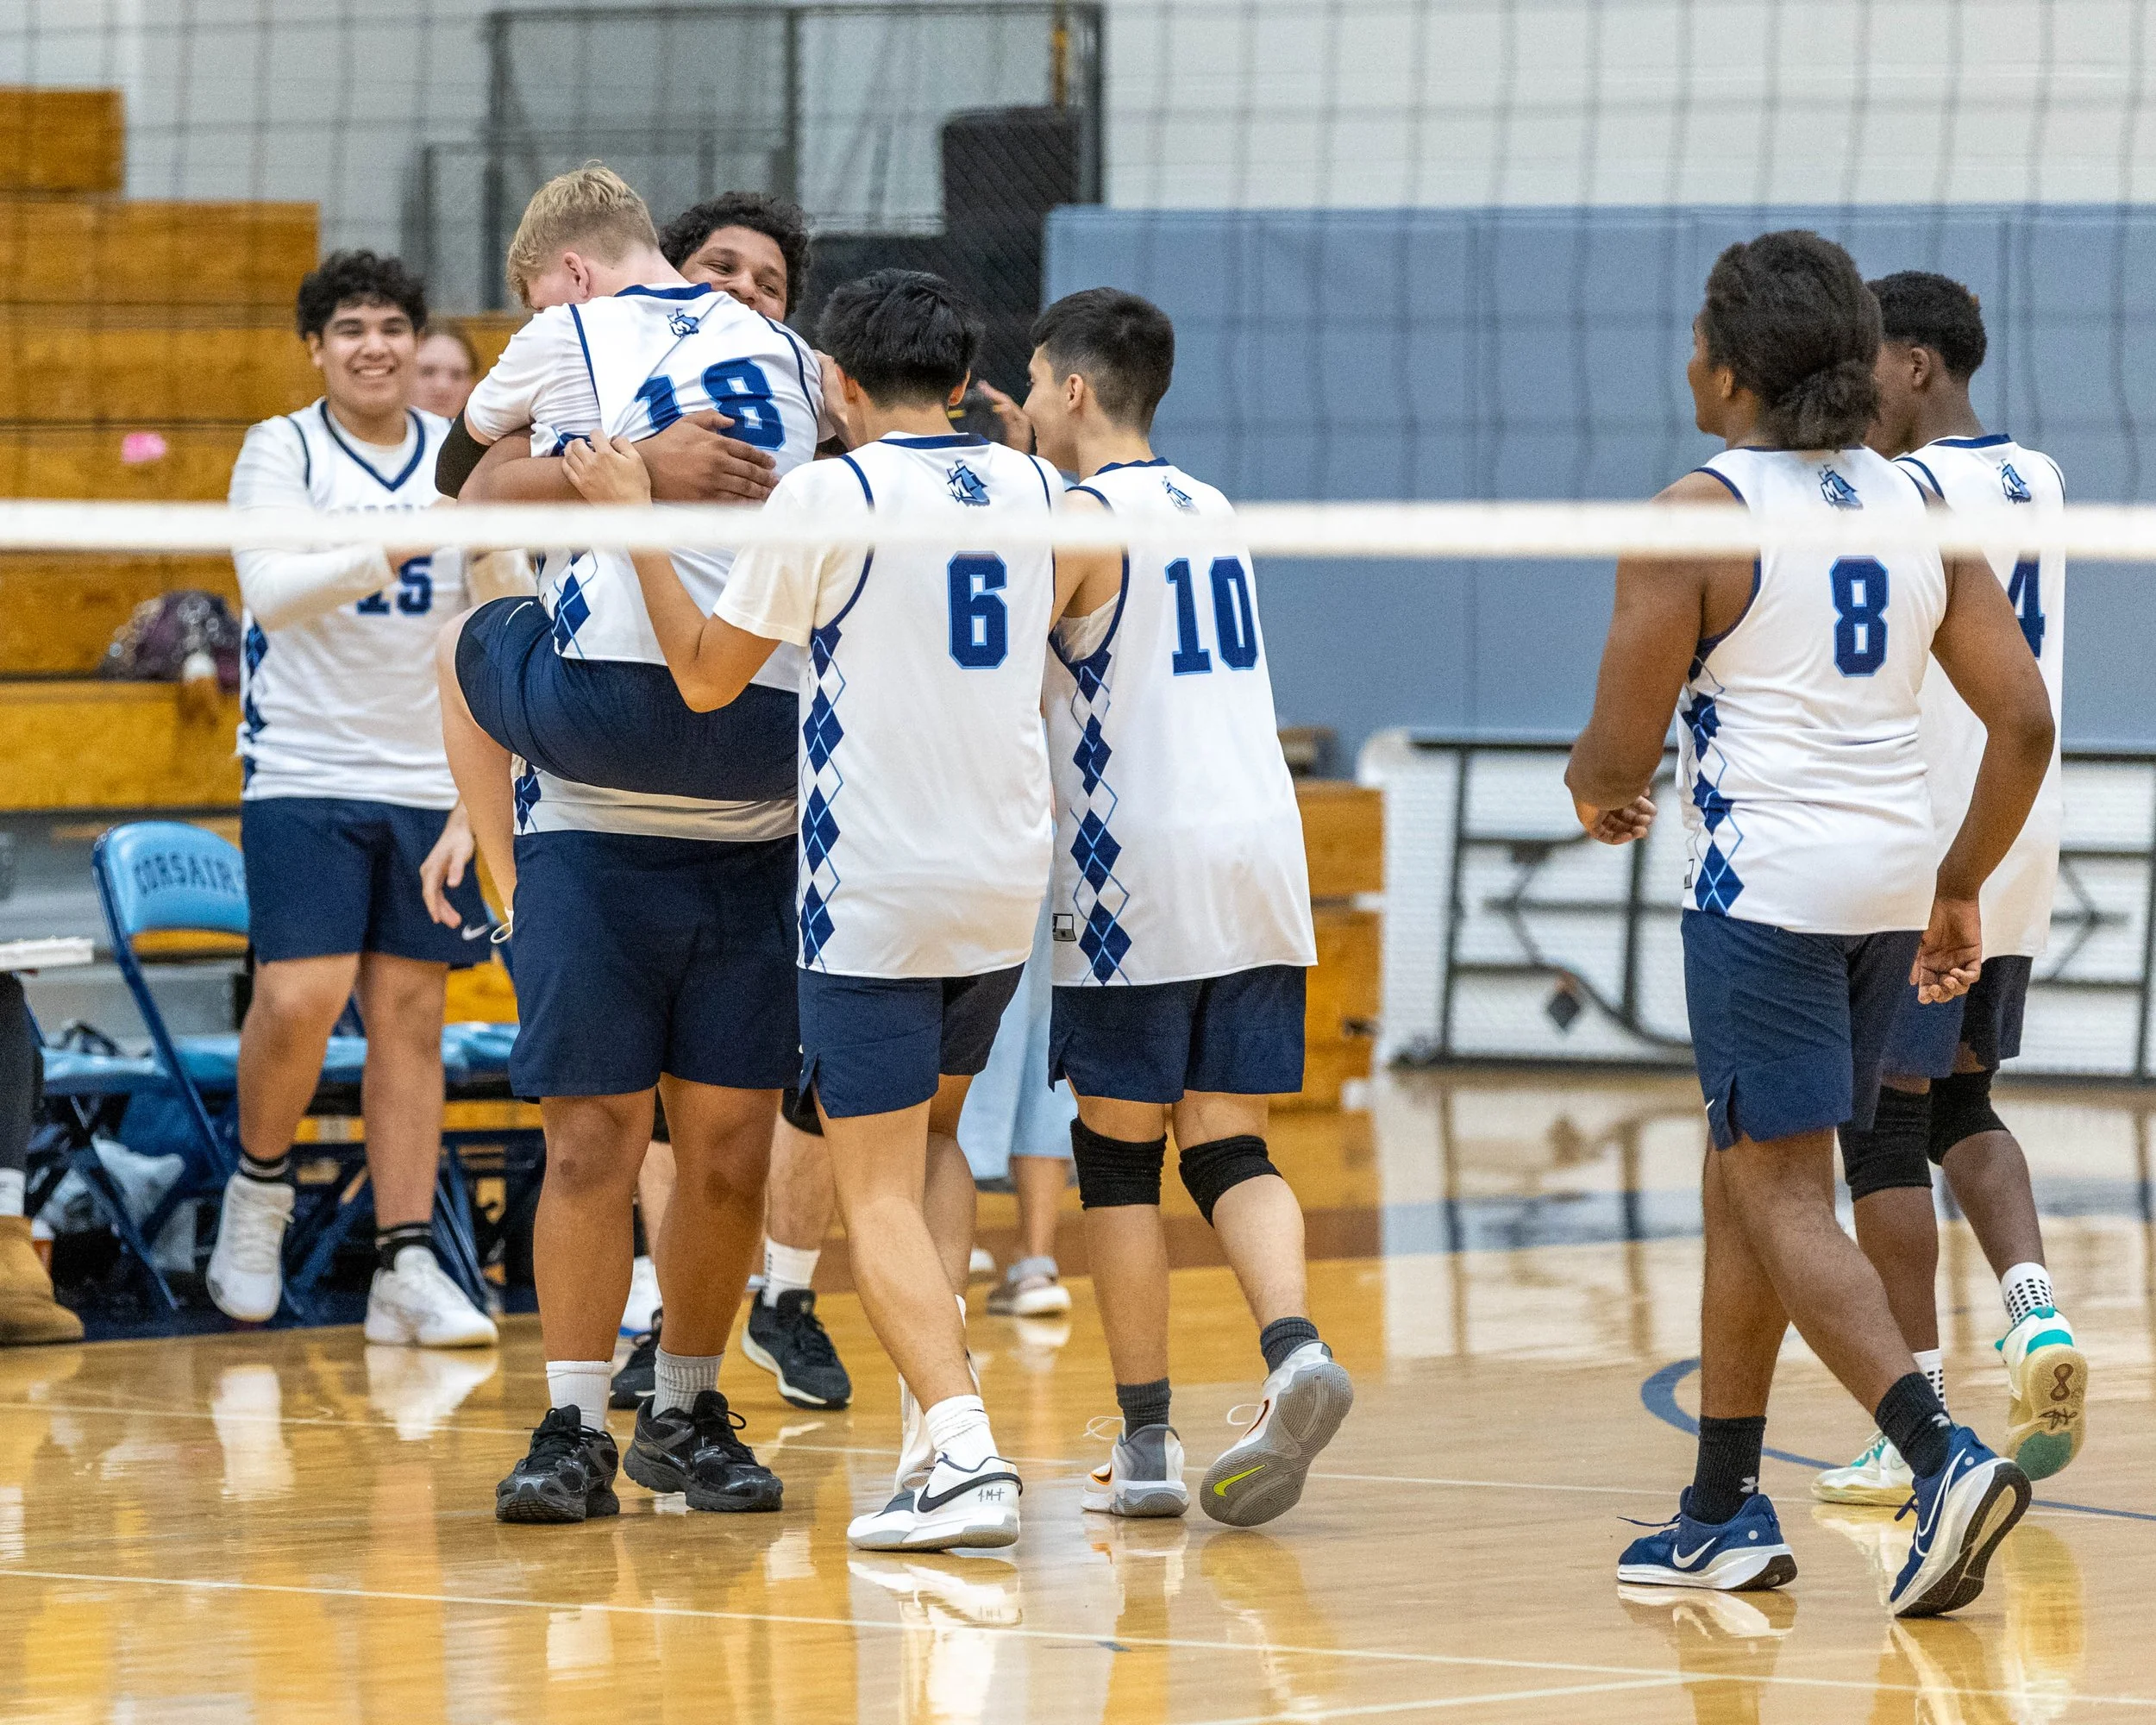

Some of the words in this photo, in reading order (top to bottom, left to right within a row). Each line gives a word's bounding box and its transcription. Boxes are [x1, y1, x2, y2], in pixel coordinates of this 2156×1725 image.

[634, 356, 787, 452] 18
[947, 550, 1008, 670] 6
[1164, 555, 1259, 676] 10
[1829, 555, 1890, 679] 8
[132, 851, 245, 897] CORSAIR
